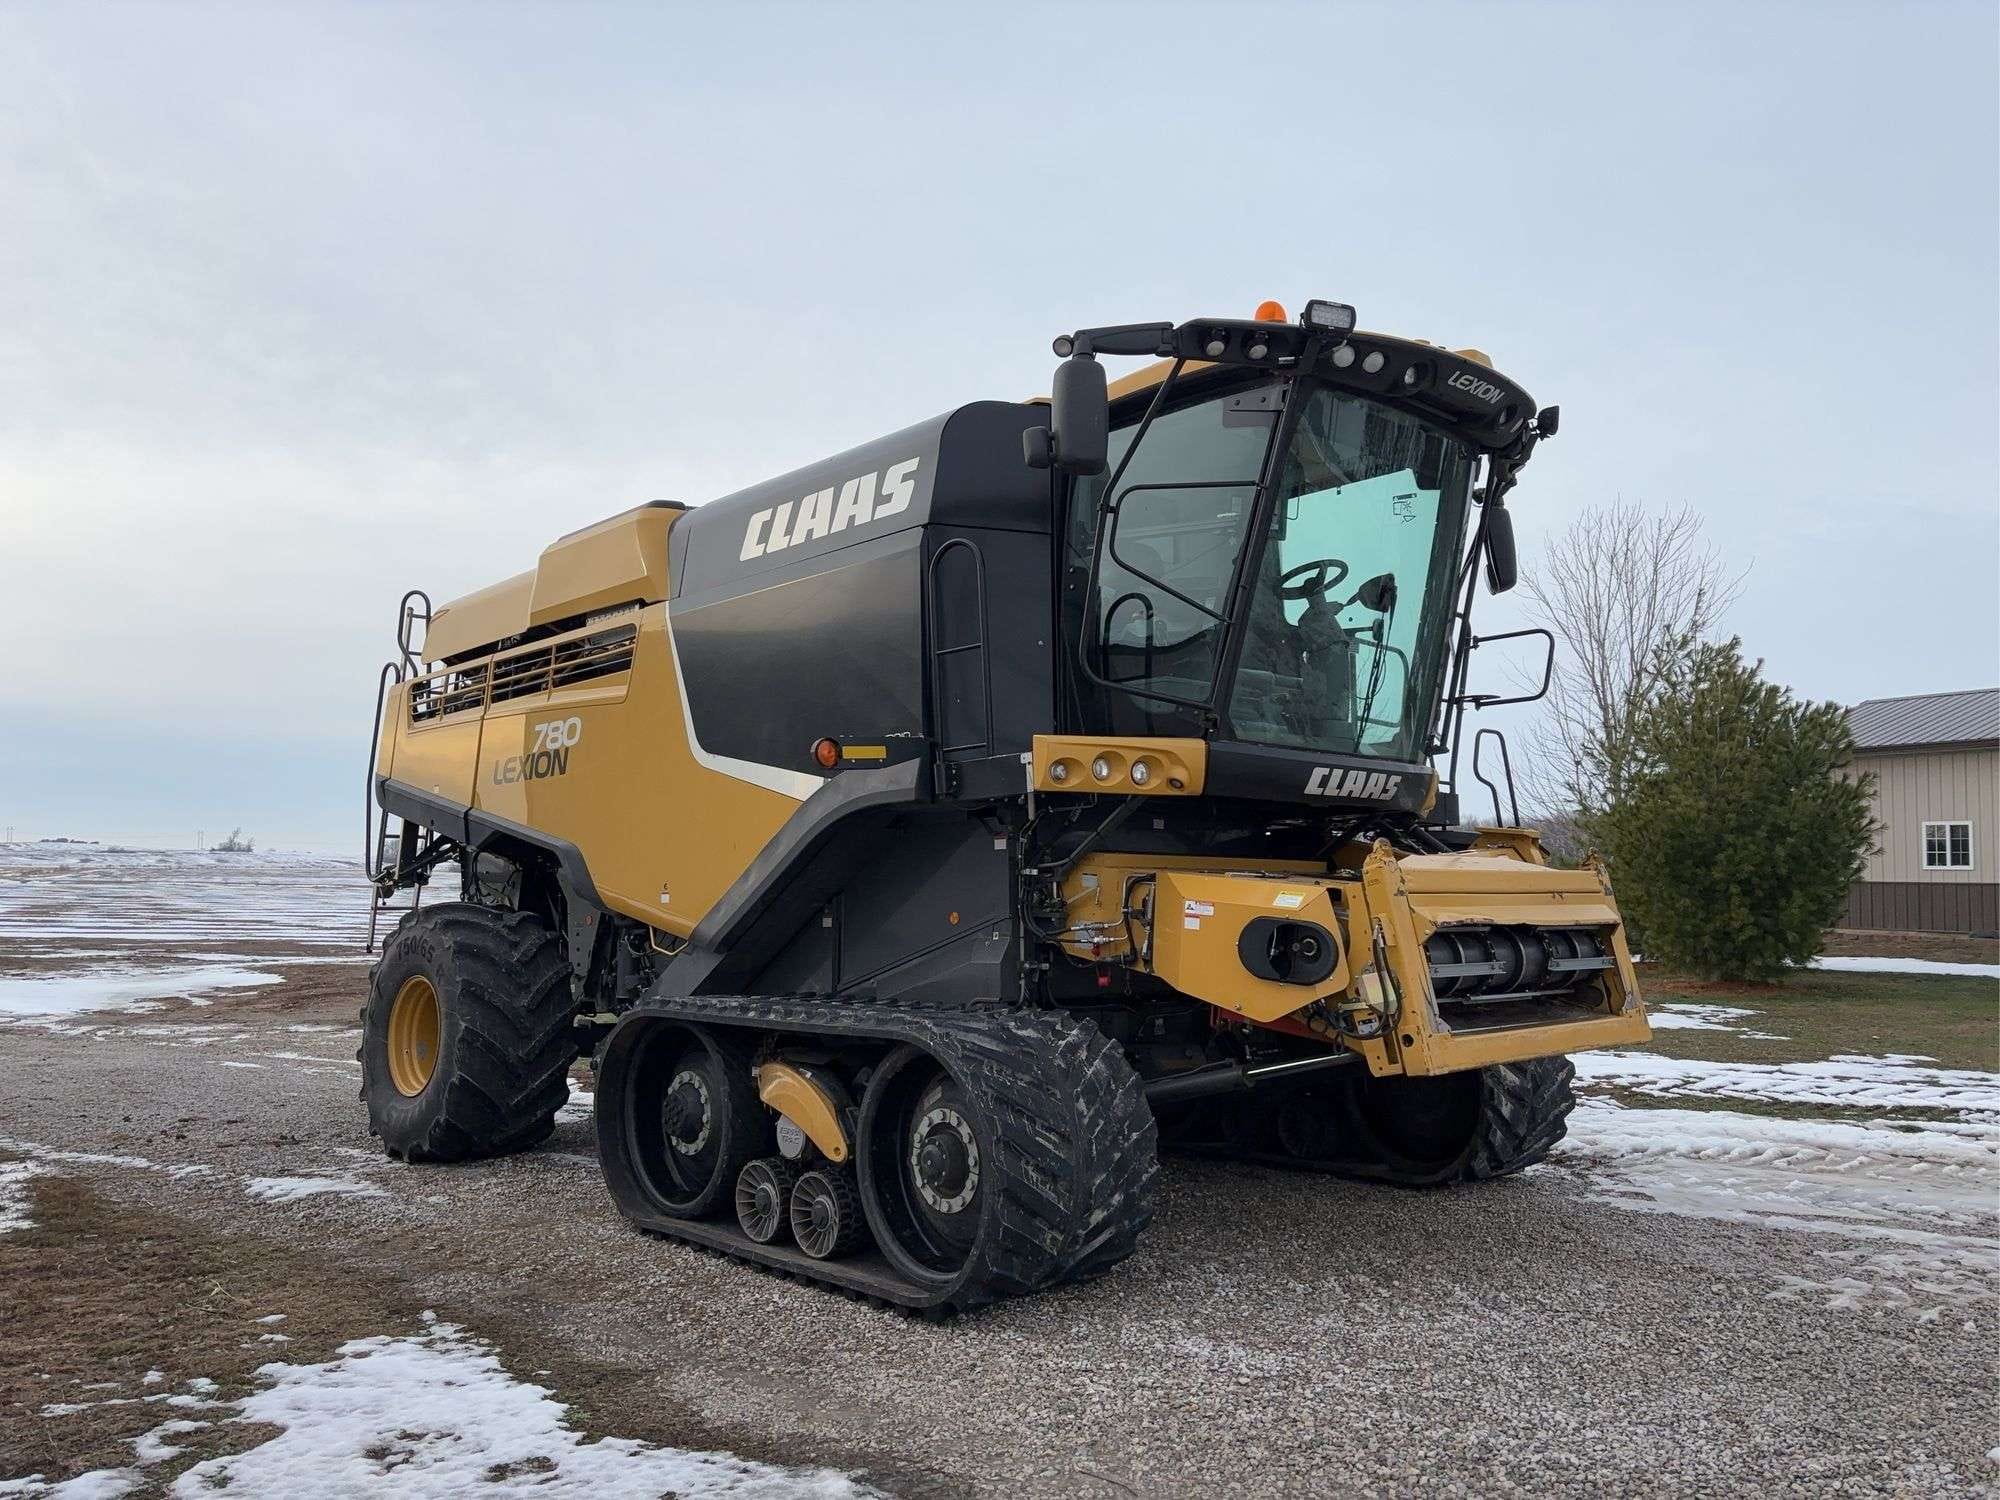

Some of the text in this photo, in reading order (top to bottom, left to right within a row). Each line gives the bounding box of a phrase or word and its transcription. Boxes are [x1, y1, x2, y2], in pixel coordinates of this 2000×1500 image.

[1447, 370, 1505, 404] LEXION
[739, 456, 920, 562] CLAAS
[532, 716, 582, 753] 780
[493, 746, 569, 785] LEXION
[1303, 766, 1402, 801] CLAAS
